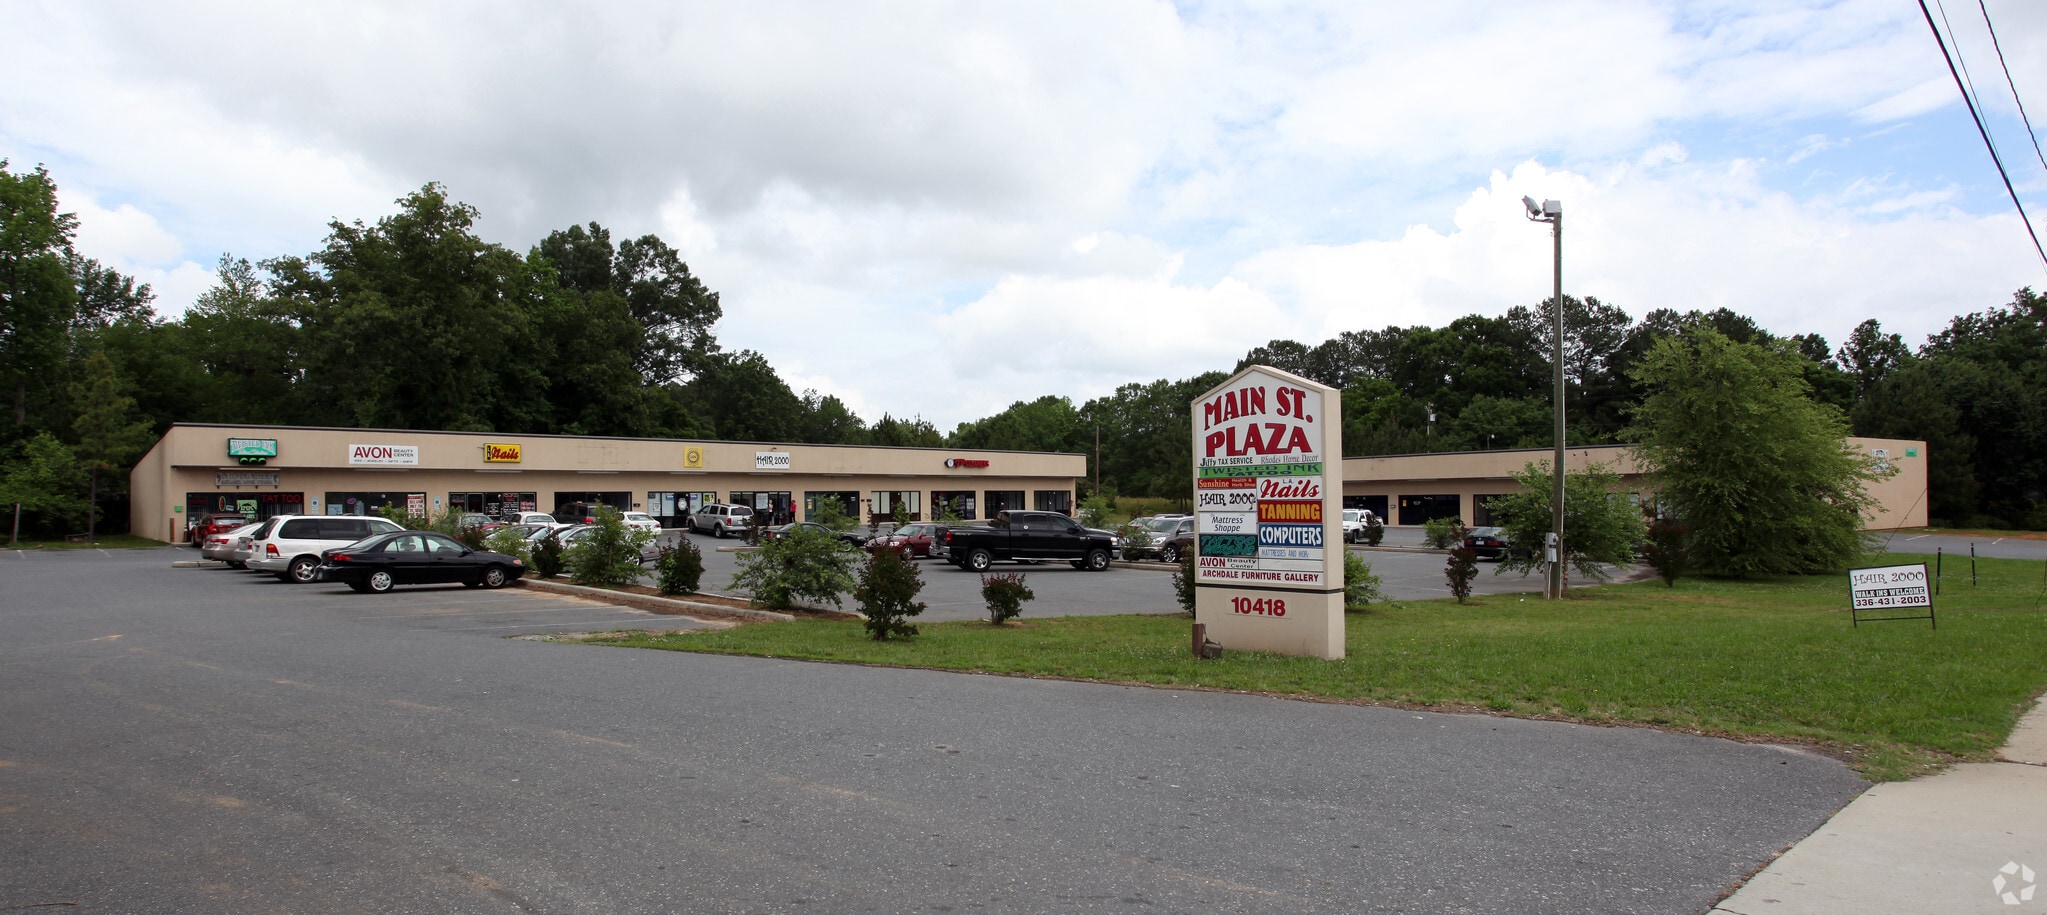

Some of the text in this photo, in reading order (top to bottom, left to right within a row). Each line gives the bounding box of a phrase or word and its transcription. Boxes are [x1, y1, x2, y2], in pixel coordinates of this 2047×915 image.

[1204, 386, 1313, 431] MAIN ST.
[1206, 423, 1312, 457] PLAZA
[354, 446, 392, 458] AVON
[491, 446, 519, 459] Nails
[757, 455, 789, 466] HAIR 2000
[1200, 458, 1216, 467] Jiffy
[1230, 457, 1253, 465] SERVICE
[1202, 464, 1320, 476] TWISTED INK
[1199, 479, 1229, 487] Sunshine
[1260, 479, 1319, 499] Nails
[1199, 492, 1256, 510] HAIR 2000
[1260, 504, 1320, 520] TANNING
[1212, 516, 1243, 524] Mattress
[1214, 524, 1240, 533] Shoppe
[1260, 526, 1322, 546] COMPUTERS
[1200, 557, 1226, 567] AVON
[1202, 569, 1319, 582] ARCHDALE FURNITURE GALLERY
[1853, 571, 1924, 586] HAIR 2000
[1855, 590, 1875, 598] WALK
[1889, 586, 1925, 596] WELCOME
[1231, 597, 1286, 617] 10418
[1856, 595, 1926, 607] 336-431-2003
